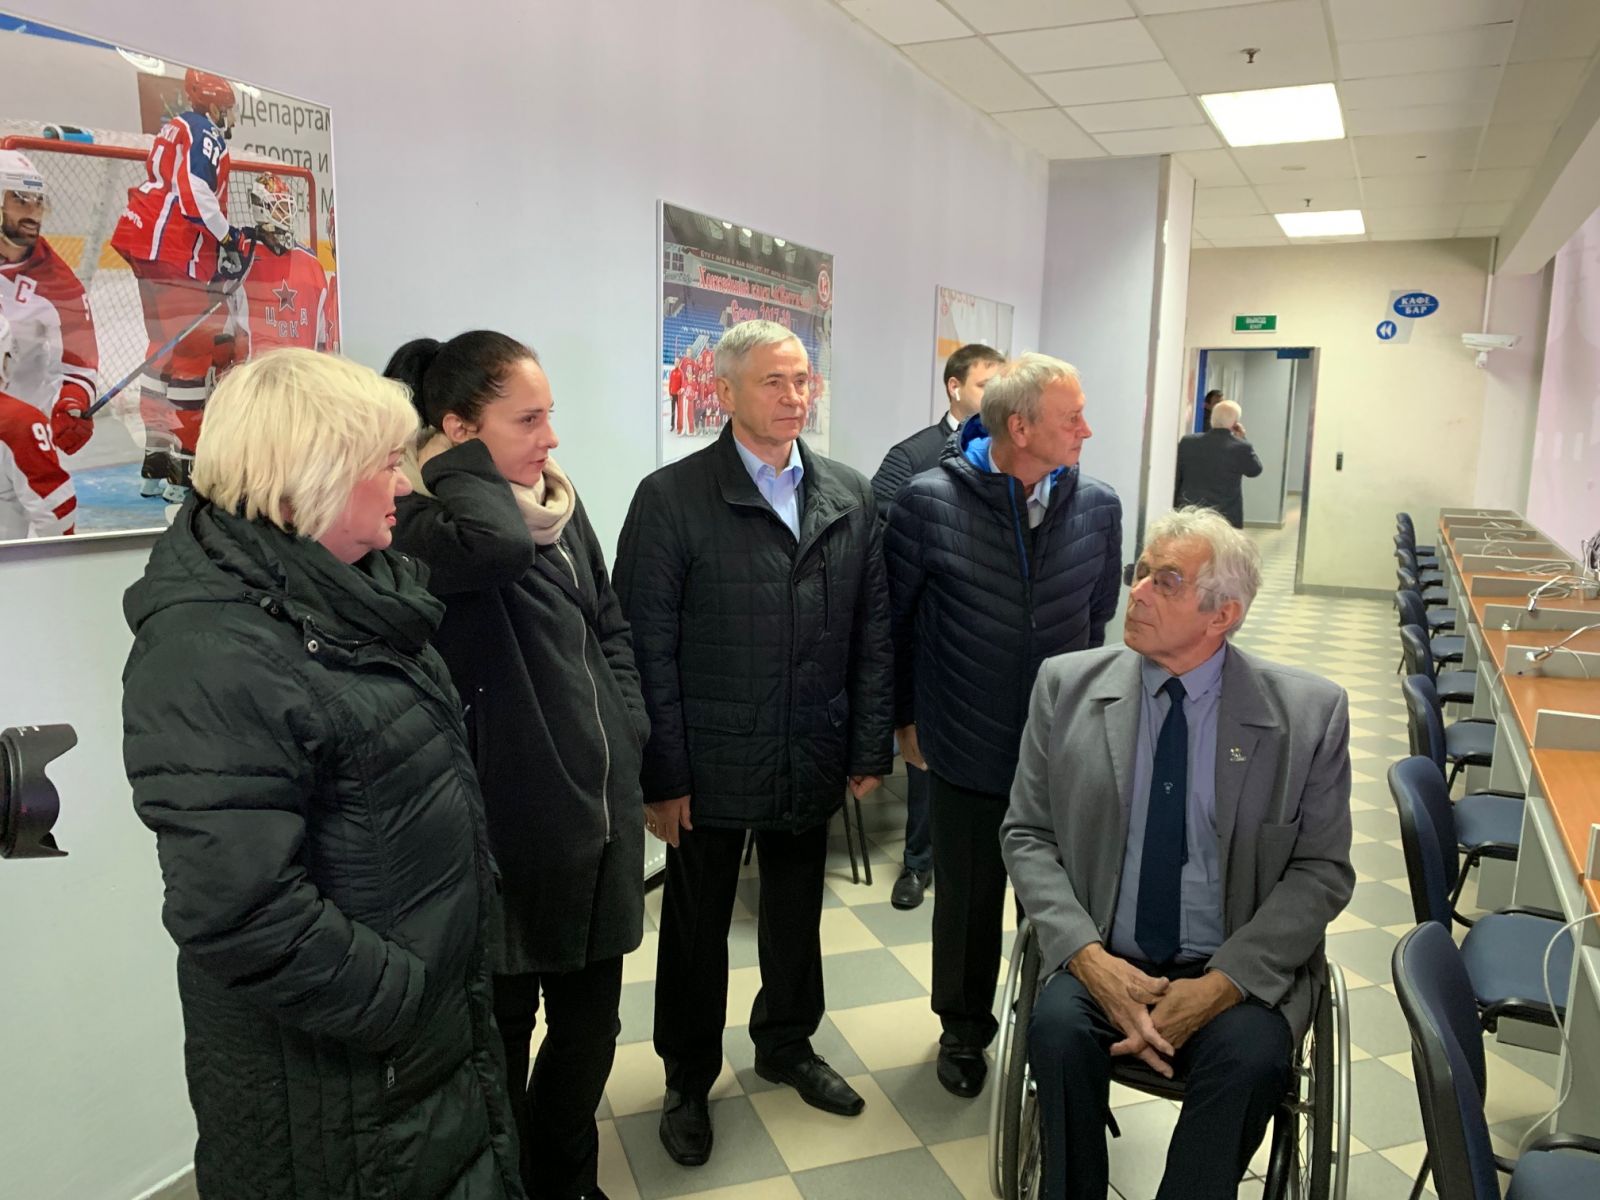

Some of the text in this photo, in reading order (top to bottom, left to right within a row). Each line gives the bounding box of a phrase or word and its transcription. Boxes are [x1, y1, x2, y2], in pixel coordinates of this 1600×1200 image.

[202, 137, 220, 166] 91
[318, 152, 329, 174] и
[1401, 296, 1430, 305] КАФЕ
[1405, 306, 1427, 315] БАР
